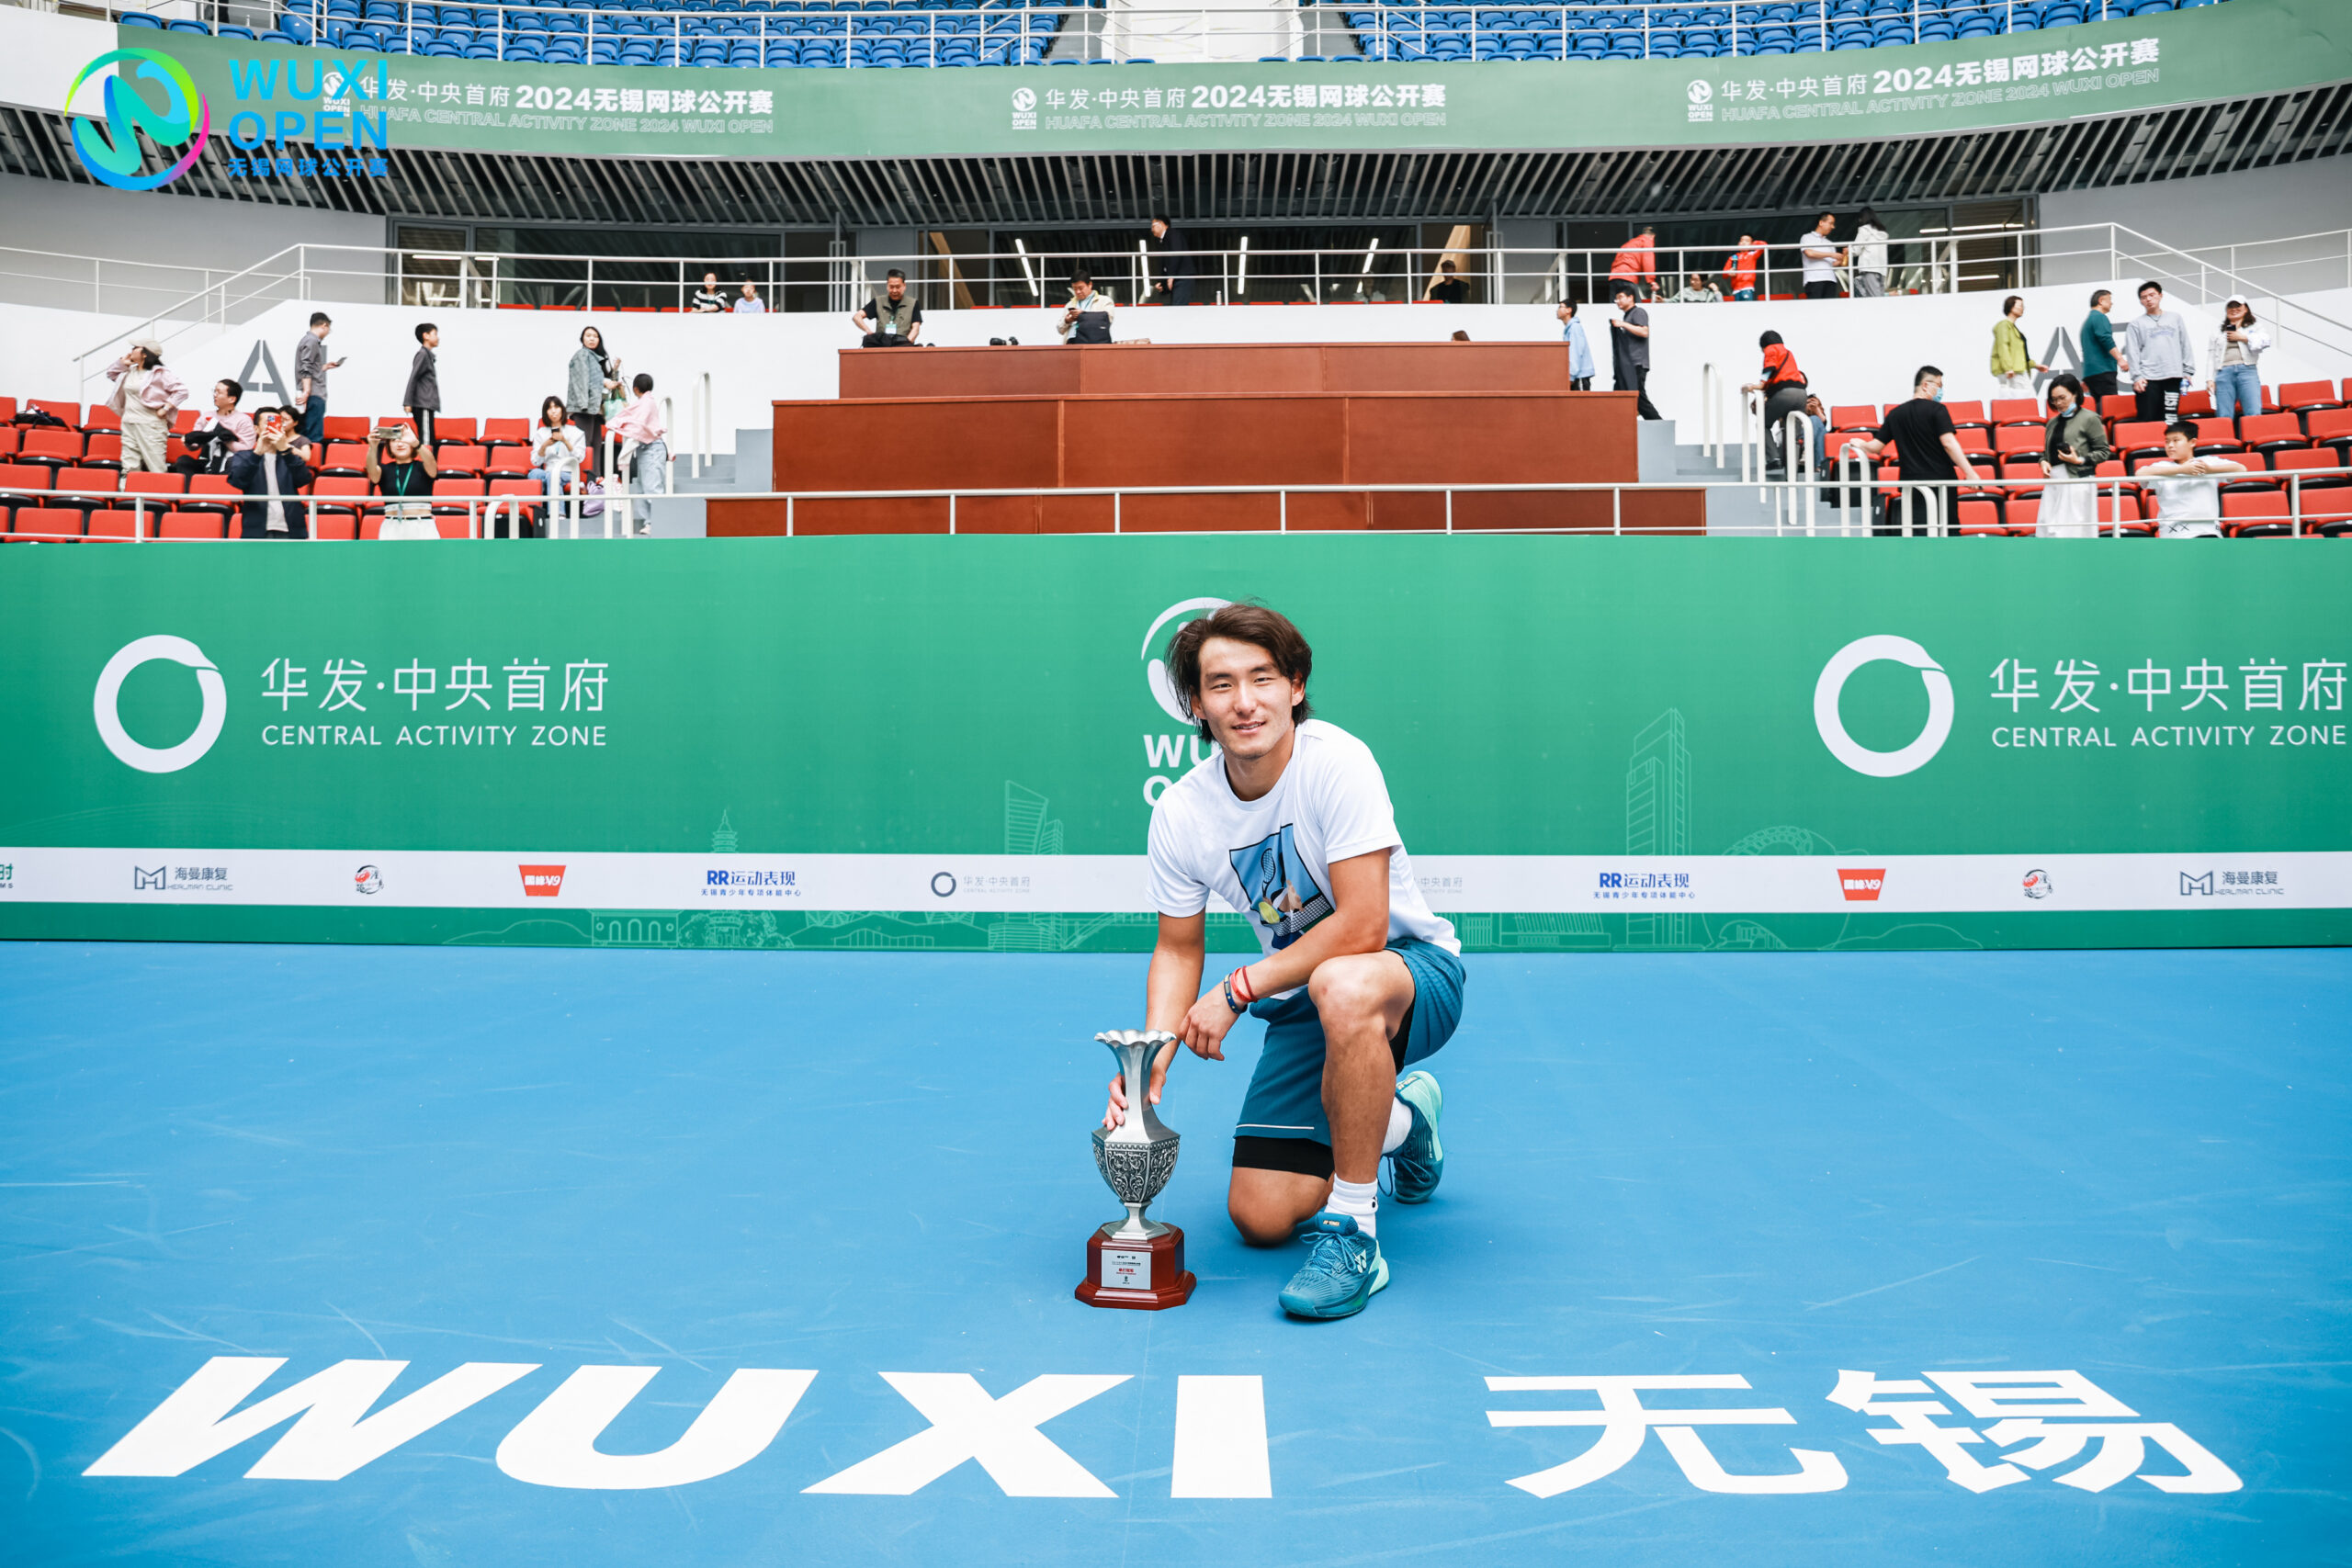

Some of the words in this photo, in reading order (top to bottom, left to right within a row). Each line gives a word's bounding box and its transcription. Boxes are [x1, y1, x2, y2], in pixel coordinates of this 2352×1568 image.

[1721, 73, 1868, 102] 华发·中央首府
[1872, 38, 2160, 94] 2024无锡网球公开赛
[514, 85, 774, 115] 2024无锡网球公开赛
[1045, 87, 1187, 110] 华发·中央首府
[1191, 84, 1446, 108] 2024无锡网球公开赛
[1721, 106, 1781, 121] HUAFA
[1782, 101, 1863, 118] CENTRAL
[1866, 94, 1950, 114] ACTIVITY
[1951, 88, 2004, 107] ZONE
[2006, 83, 2050, 101] 2024
[2052, 75, 2103, 96] WUXI
[2105, 68, 2160, 89] OPEN
[424, 107, 506, 127] CENTRAL
[507, 114, 588, 130] ACTIVITY
[590, 118, 638, 131] ZONE
[639, 118, 680, 133] 2024
[682, 119, 726, 133] WUXI
[728, 119, 774, 133] OPEN
[1045, 115, 1102, 130] HUAFA
[1105, 114, 1182, 129] CENTRAL
[1184, 113, 1261, 128] ACTIVITY
[1264, 114, 1311, 127] ZONE
[1313, 113, 1352, 127] 2024
[1354, 113, 1398, 126] WUXI
[1400, 113, 1446, 126] OPEN
[261, 657, 610, 712] 华发·中央首府
[1988, 657, 2348, 713] 华发·中央首府
[261, 725, 381, 746] CENTRAL
[396, 726, 517, 746] ACTIVITY
[531, 726, 606, 746] ZONE
[1991, 726, 2117, 748] CENTRAL
[2131, 726, 2256, 747] ACTIVITY
[2269, 725, 2347, 746] ZONE
[1143, 734, 1223, 768] WU
[175, 866, 229, 881] 海曼康复
[2222, 870, 2278, 885] 海曼康复
[82, 1356, 1273, 1499] WUXI
[1483, 1369, 2245, 1499] 无锡
